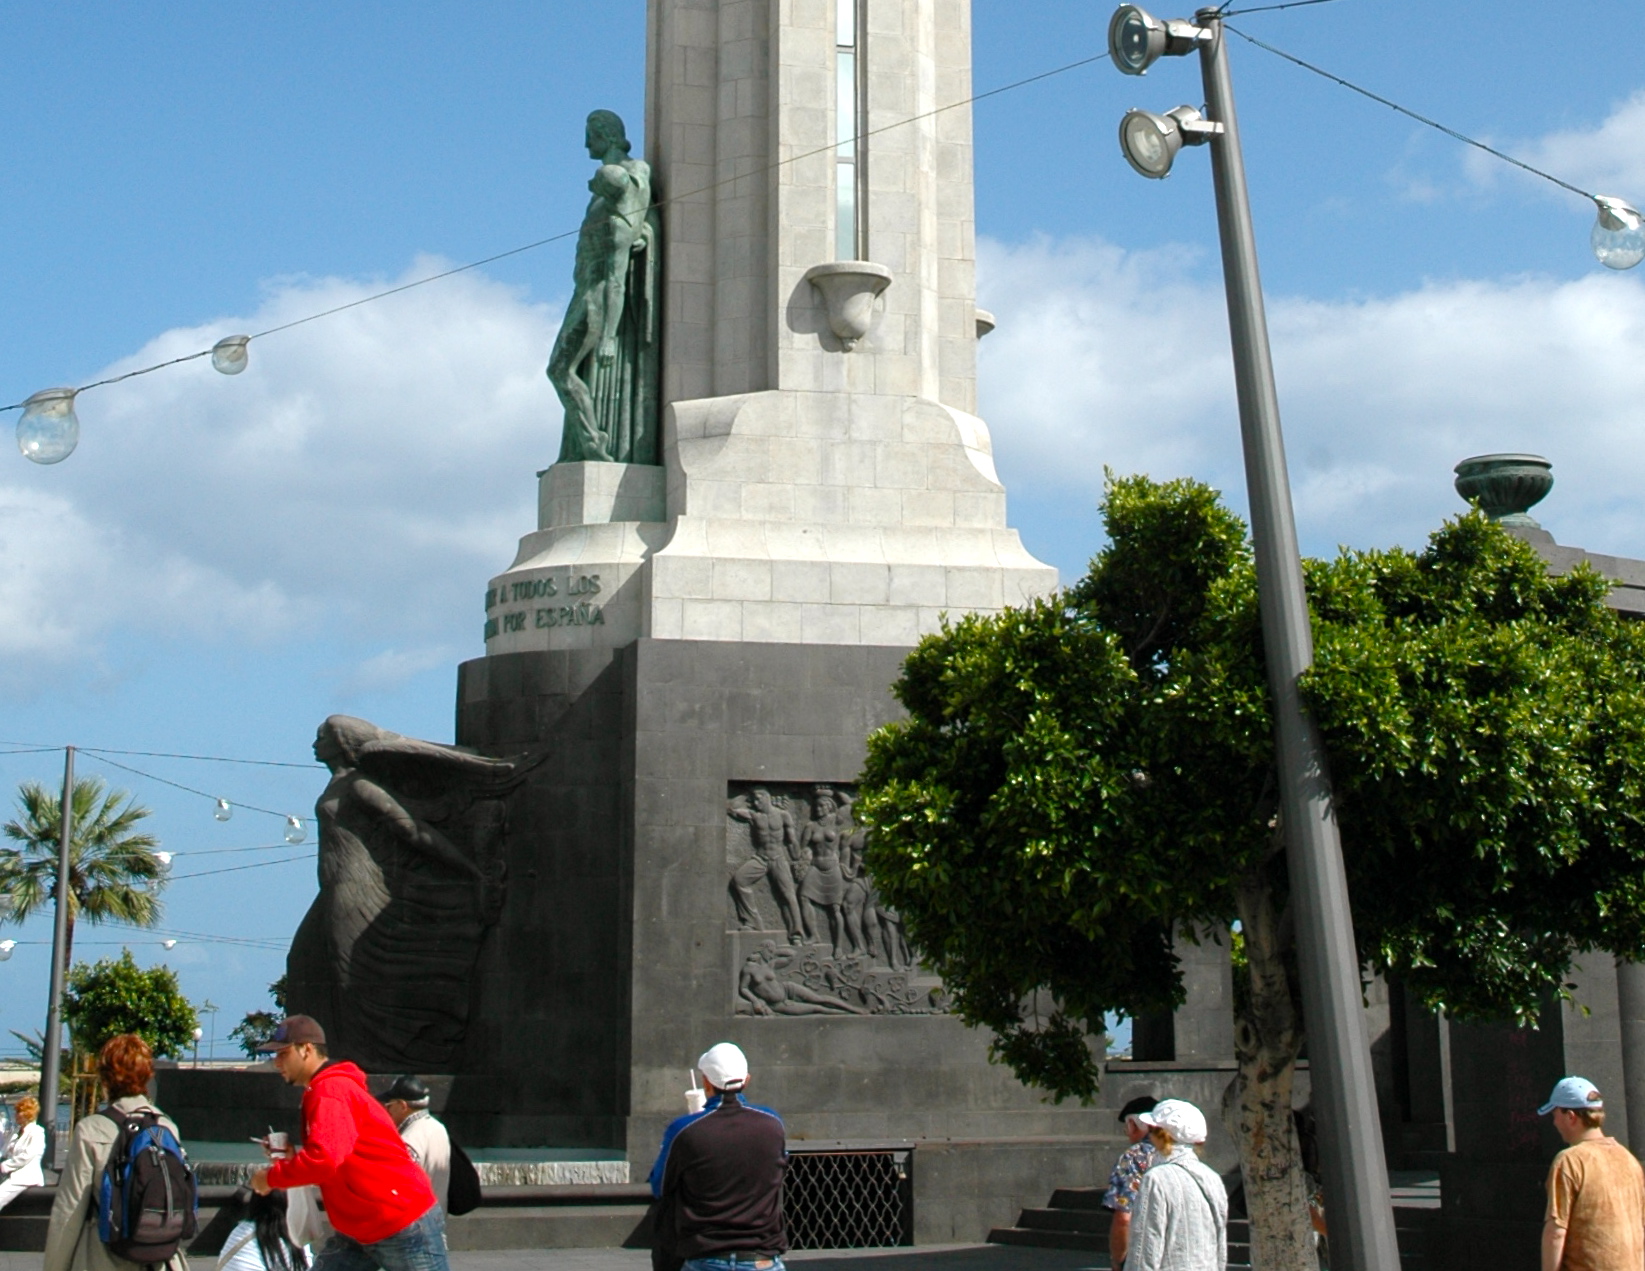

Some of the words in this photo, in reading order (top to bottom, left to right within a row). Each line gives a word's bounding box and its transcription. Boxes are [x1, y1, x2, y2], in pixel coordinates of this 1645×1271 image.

[500, 584, 508, 603] A
[512, 577, 557, 601] TODOS
[568, 575, 601, 595] LOS
[503, 610, 526, 633] POR
[536, 602, 605, 629] ESPAÑA
